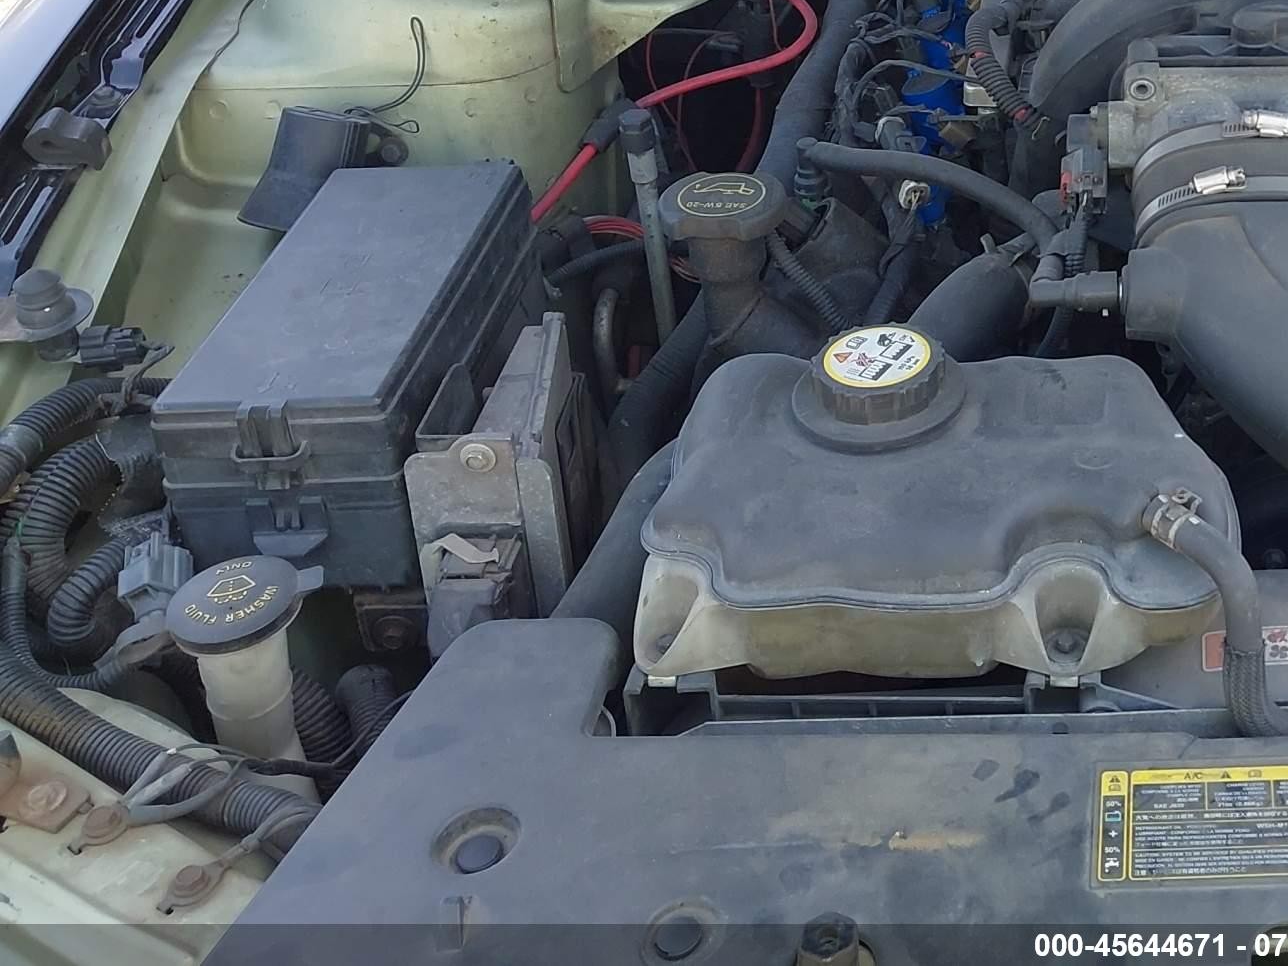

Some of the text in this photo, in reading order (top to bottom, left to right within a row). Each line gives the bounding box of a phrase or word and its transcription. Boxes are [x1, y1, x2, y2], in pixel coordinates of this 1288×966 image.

[686, 201, 722, 209] 5W-20
[215, 561, 253, 575] ONLY
[184, 585, 280, 625] WASHER FLUID
[1184, 772, 1203, 780] A/C
[1104, 846, 1120, 854] 50%
